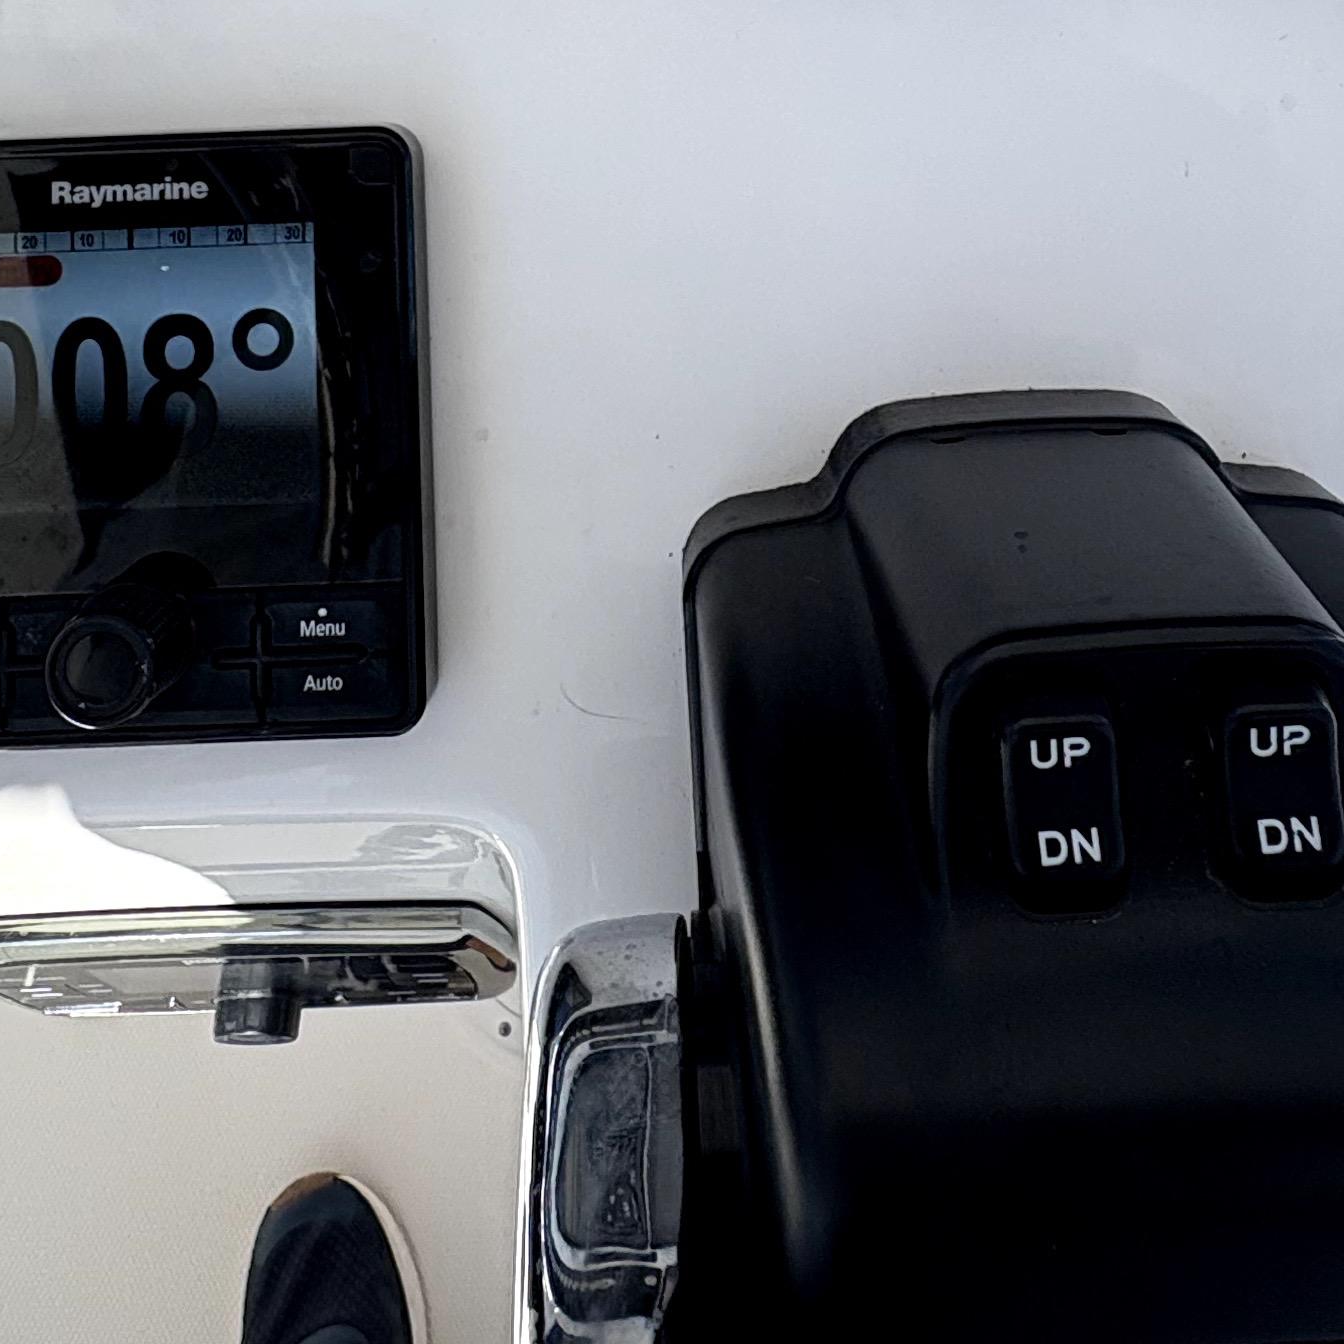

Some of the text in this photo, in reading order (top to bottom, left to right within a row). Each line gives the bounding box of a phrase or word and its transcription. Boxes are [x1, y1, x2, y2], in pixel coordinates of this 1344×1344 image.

[52, 177, 208, 207] Raymarine
[21, 235, 39, 249] 20
[78, 233, 95, 248] 10
[168, 229, 186, 244] 10
[226, 228, 244, 242] 20
[283, 226, 301, 240] 30
[301, 621, 345, 636] Menu
[304, 675, 343, 691] Auto
[1031, 737, 1090, 768] UP
[1251, 725, 1310, 757] UP
[1038, 827, 1101, 866] DN
[1258, 816, 1321, 854] DN
